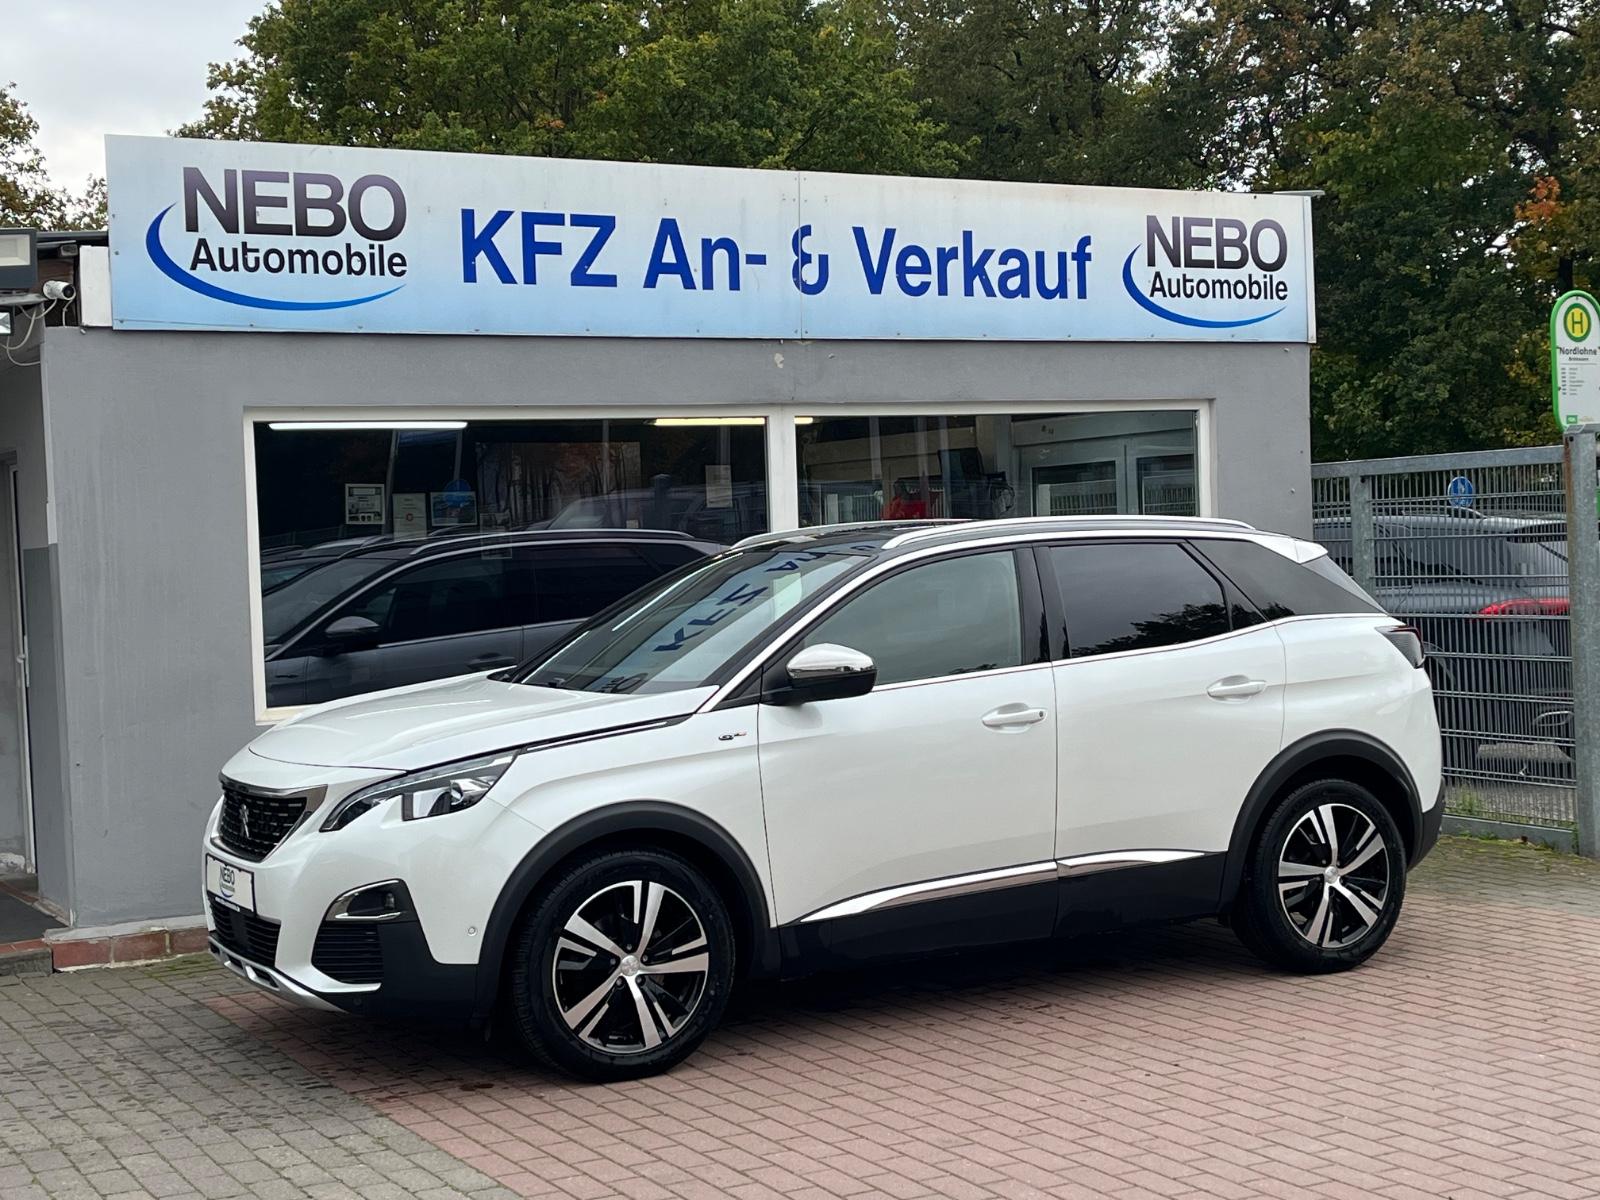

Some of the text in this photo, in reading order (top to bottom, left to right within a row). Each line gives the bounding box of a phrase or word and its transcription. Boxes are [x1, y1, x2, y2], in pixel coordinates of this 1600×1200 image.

[184, 167, 407, 242] NEBO
[189, 237, 408, 278] Automobile
[461, 208, 1092, 300] KFZ An- & Verkauf
[1146, 215, 1288, 273] NEBO
[1149, 271, 1288, 301] Automobile
[1559, 346, 1597, 355] Nordlohne
[219, 865, 236, 886] NEBO
